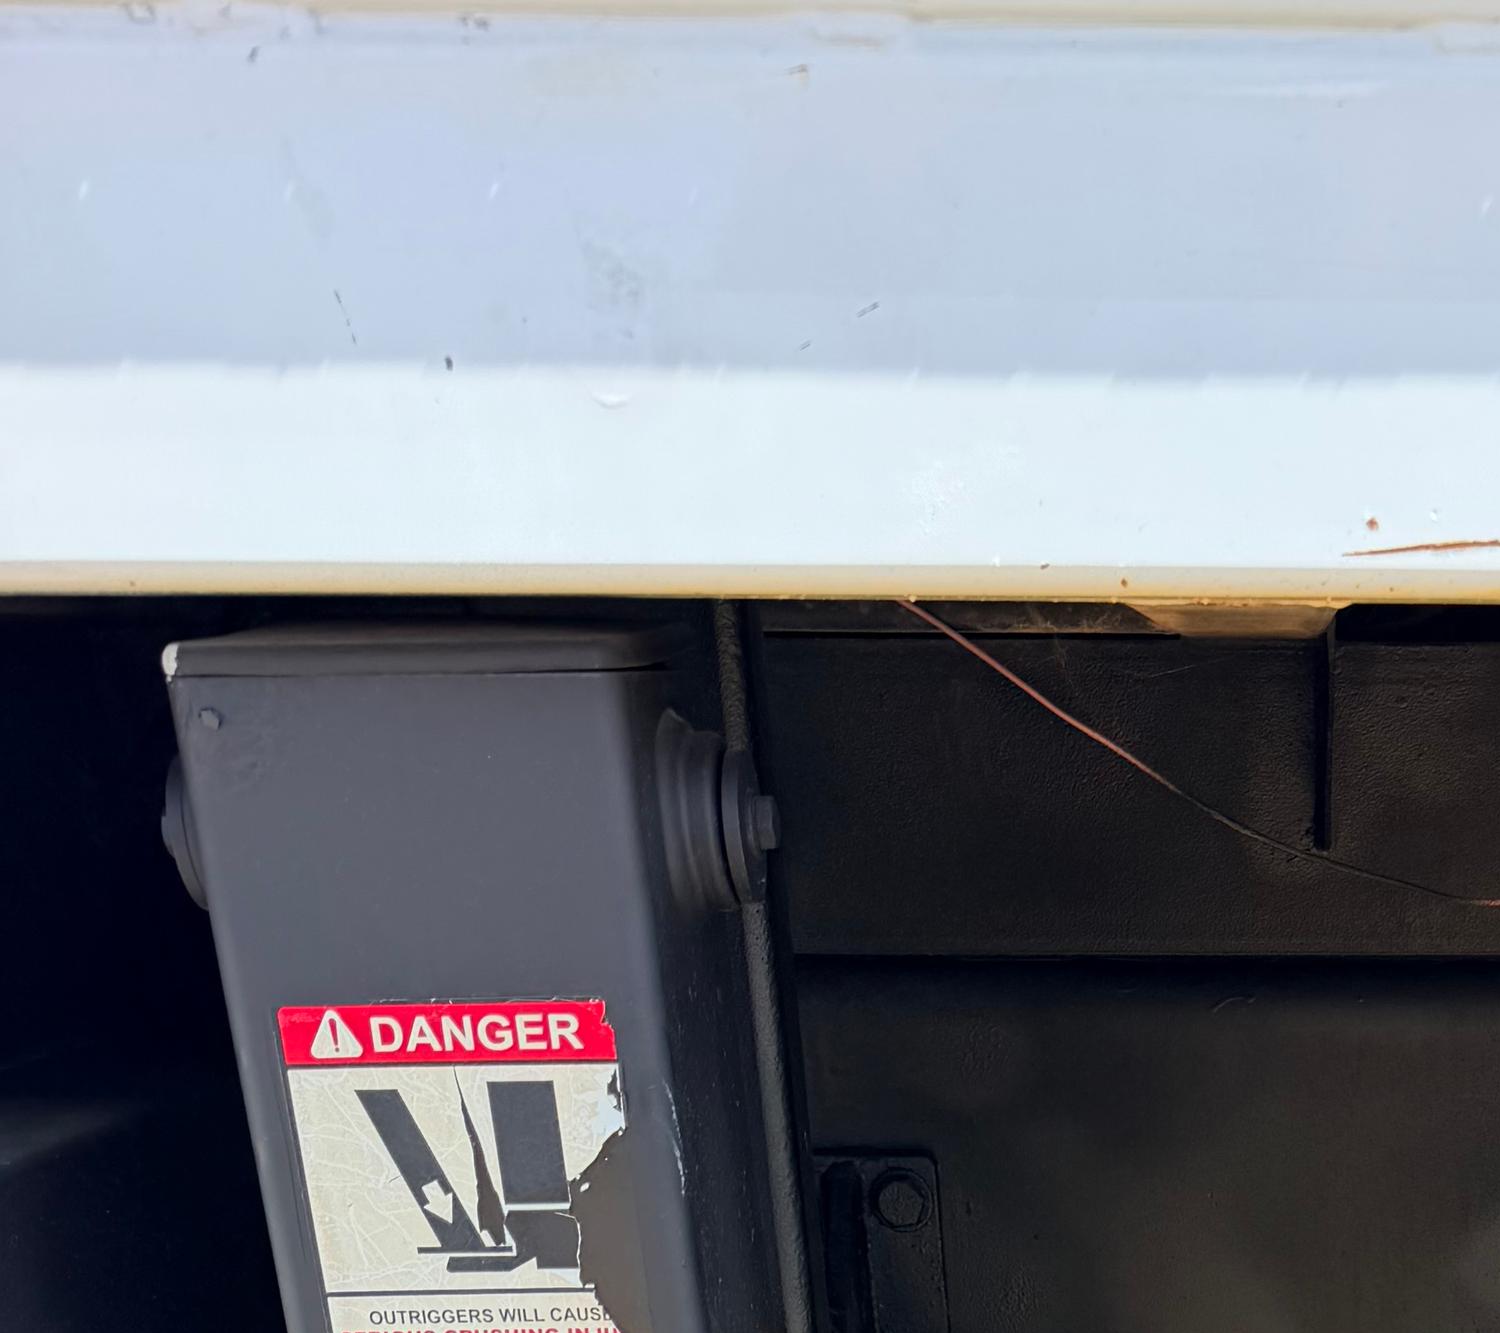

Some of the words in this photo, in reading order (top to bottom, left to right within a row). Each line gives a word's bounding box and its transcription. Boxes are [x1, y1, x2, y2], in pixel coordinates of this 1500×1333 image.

[369, 1013, 584, 1052] DANGER
[370, 1308, 493, 1325] OUTRIGGERS
[499, 1307, 545, 1323] WILL
